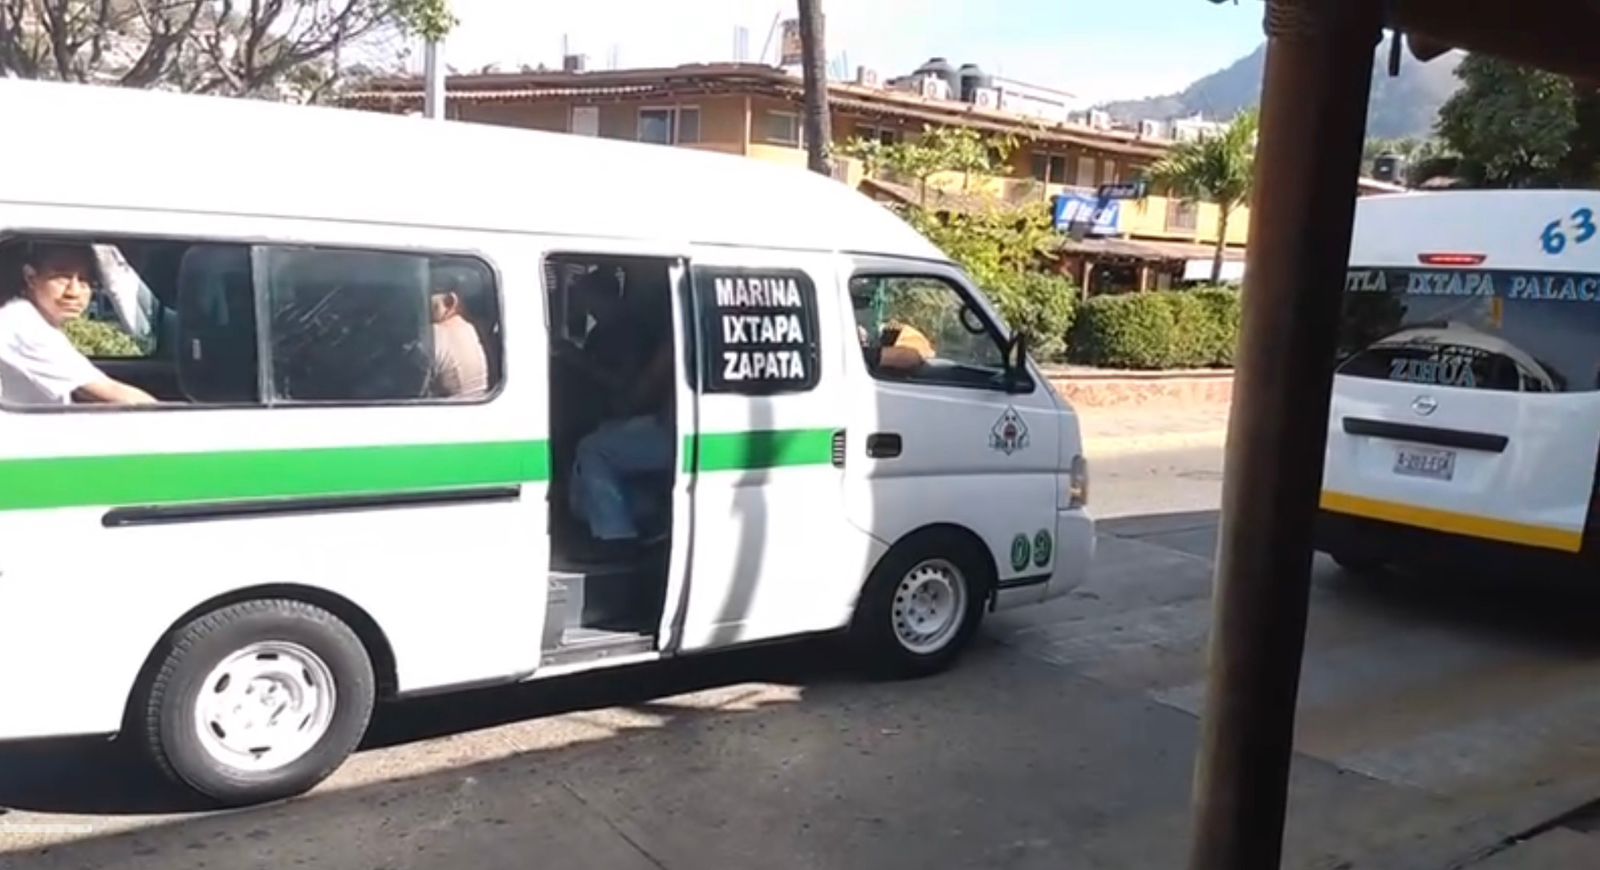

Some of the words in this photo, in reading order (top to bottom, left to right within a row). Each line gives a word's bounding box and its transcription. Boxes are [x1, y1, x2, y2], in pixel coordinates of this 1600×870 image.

[1540, 208, 1597, 255] 63
[715, 277, 802, 307] MARINA
[1346, 270, 1388, 292] TLA
[1406, 272, 1495, 296] IXTAPA
[1508, 275, 1600, 301] PALAC
[722, 314, 804, 344] IXTAPA
[723, 350, 805, 380] ZAPATA
[1390, 357, 1477, 388] ZIHUA
[1010, 528, 1053, 573] 09
